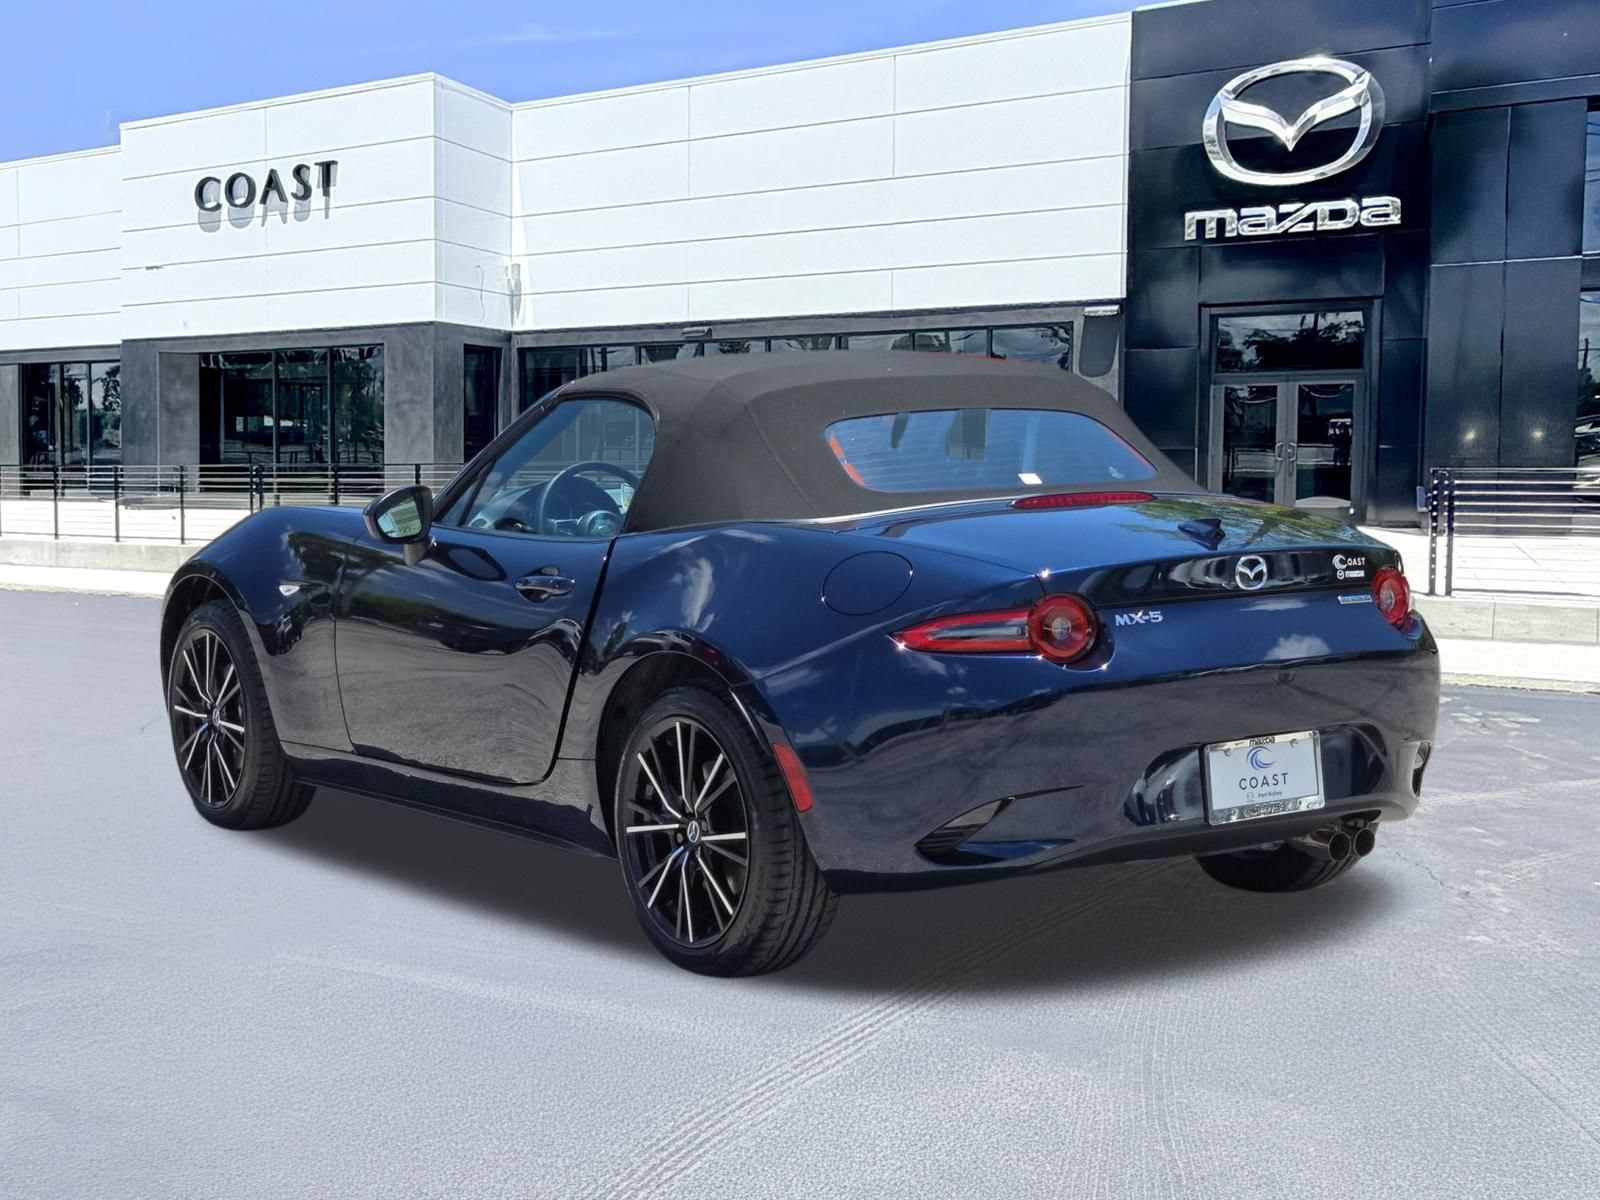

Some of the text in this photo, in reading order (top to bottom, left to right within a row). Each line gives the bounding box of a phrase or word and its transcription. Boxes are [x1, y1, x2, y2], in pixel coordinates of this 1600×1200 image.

[194, 160, 338, 212] COAST
[1115, 610, 1163, 626] MX-5
[1239, 772, 1288, 790] COAST
